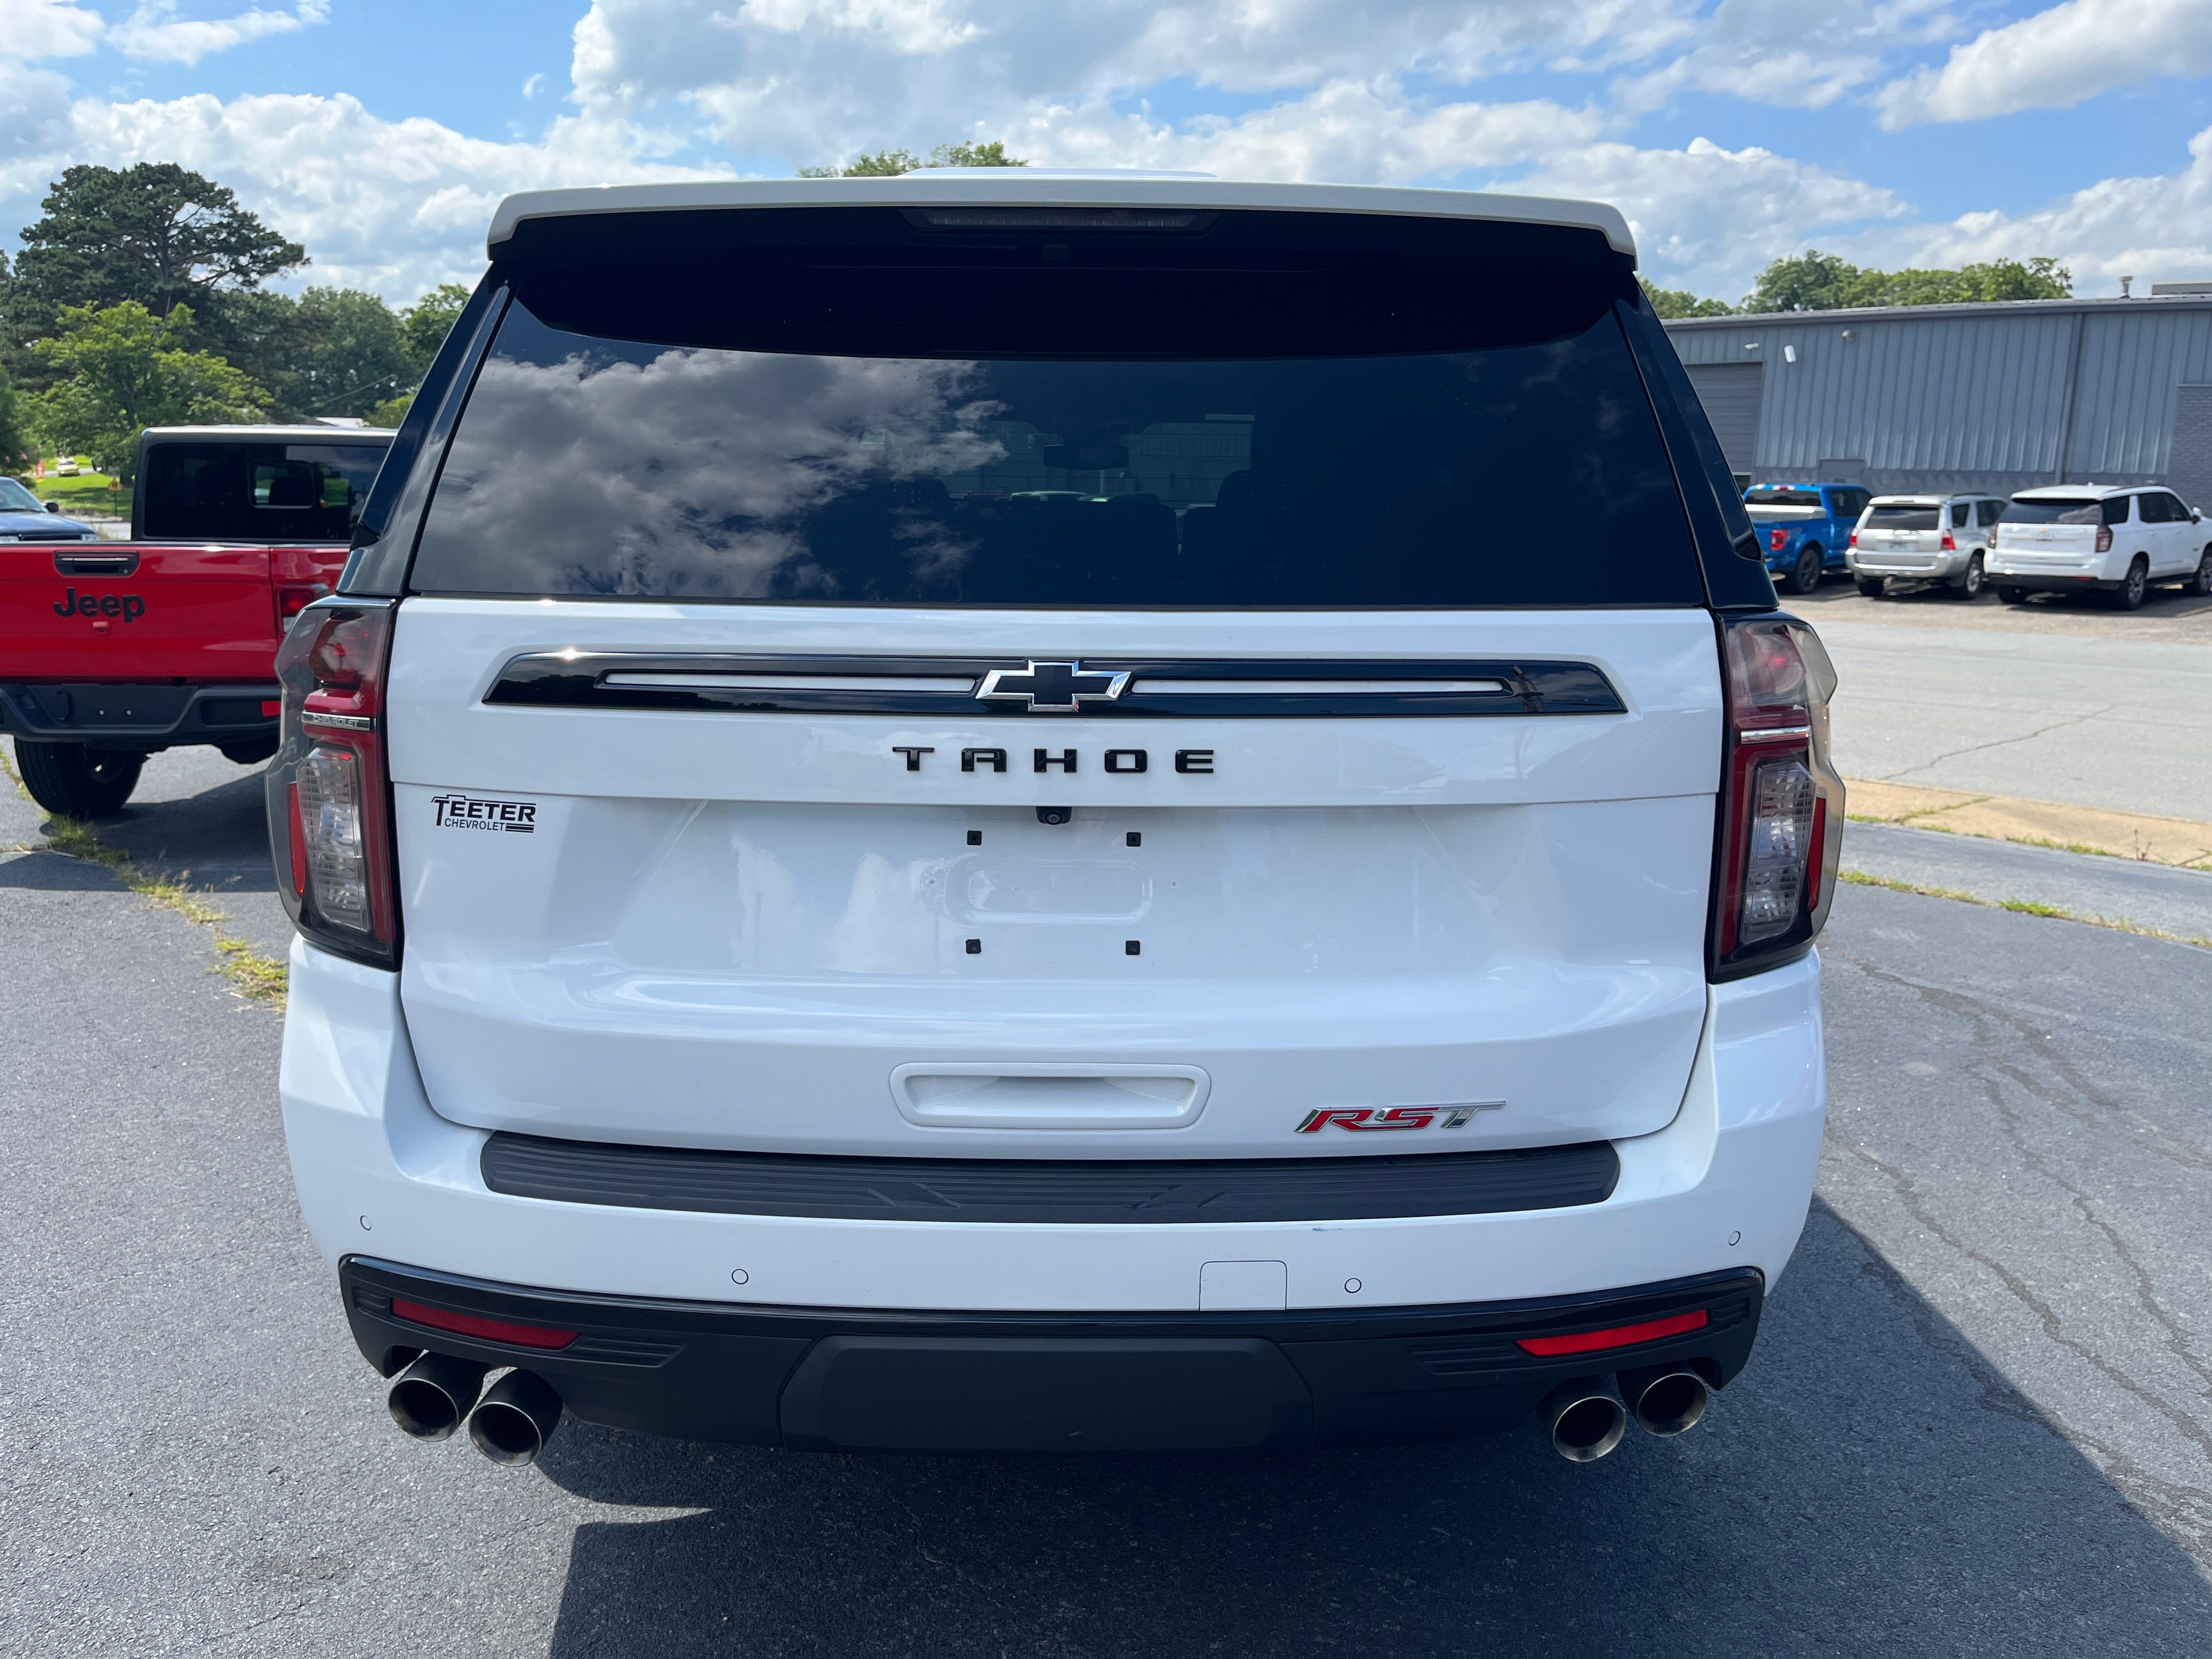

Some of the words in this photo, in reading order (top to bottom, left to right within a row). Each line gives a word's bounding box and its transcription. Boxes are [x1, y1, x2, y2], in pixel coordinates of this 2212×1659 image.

[53, 586, 145, 623] Jeep
[313, 714, 359, 727] CHEVROLET
[892, 747, 1214, 774] TAHOE
[434, 799, 536, 826] TEETER
[444, 818, 505, 831] CHEVROLET
[1294, 1101, 1506, 1133] RST
